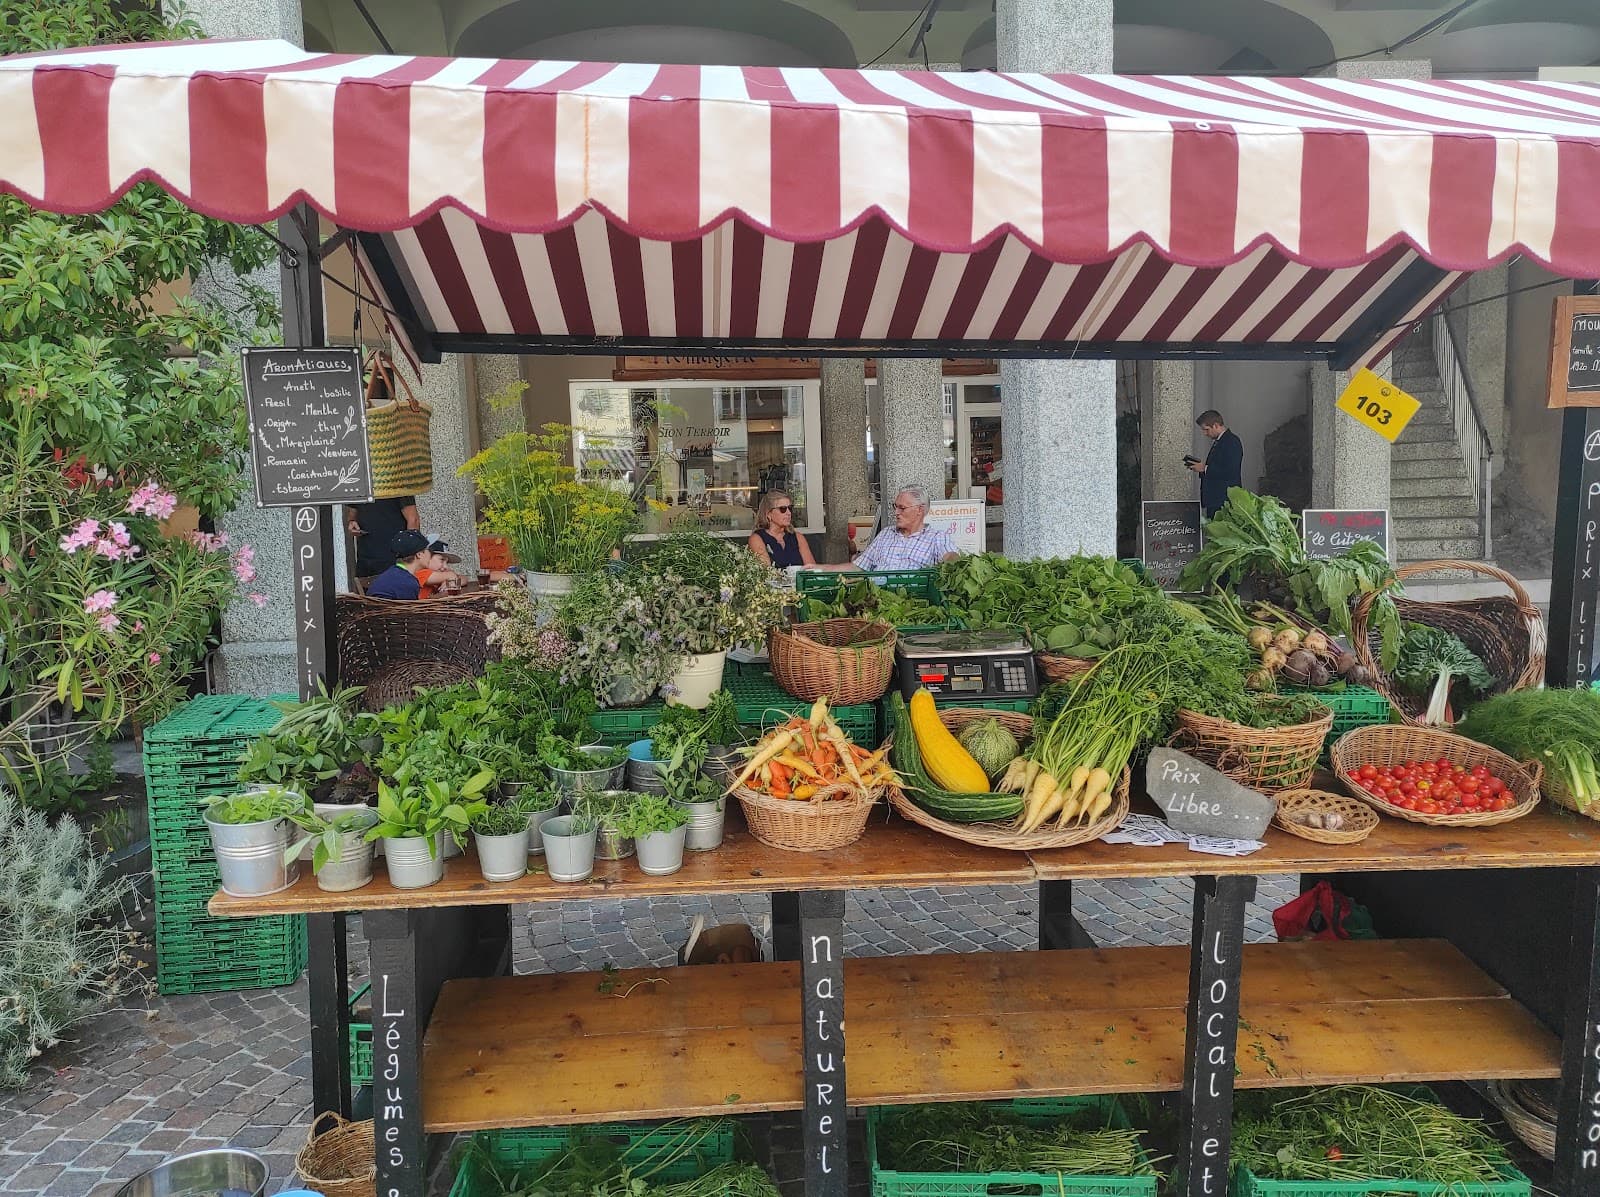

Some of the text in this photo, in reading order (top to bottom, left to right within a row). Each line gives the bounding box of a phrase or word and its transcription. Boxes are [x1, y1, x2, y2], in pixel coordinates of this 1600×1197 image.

[285, 380, 316, 391] Aneth
[323, 387, 352, 399] basilic
[305, 403, 340, 416] Menthe
[1356, 395, 1393, 425] 103
[382, 974, 405, 1167] Légumes
[1201, 931, 1227, 1194] local et
